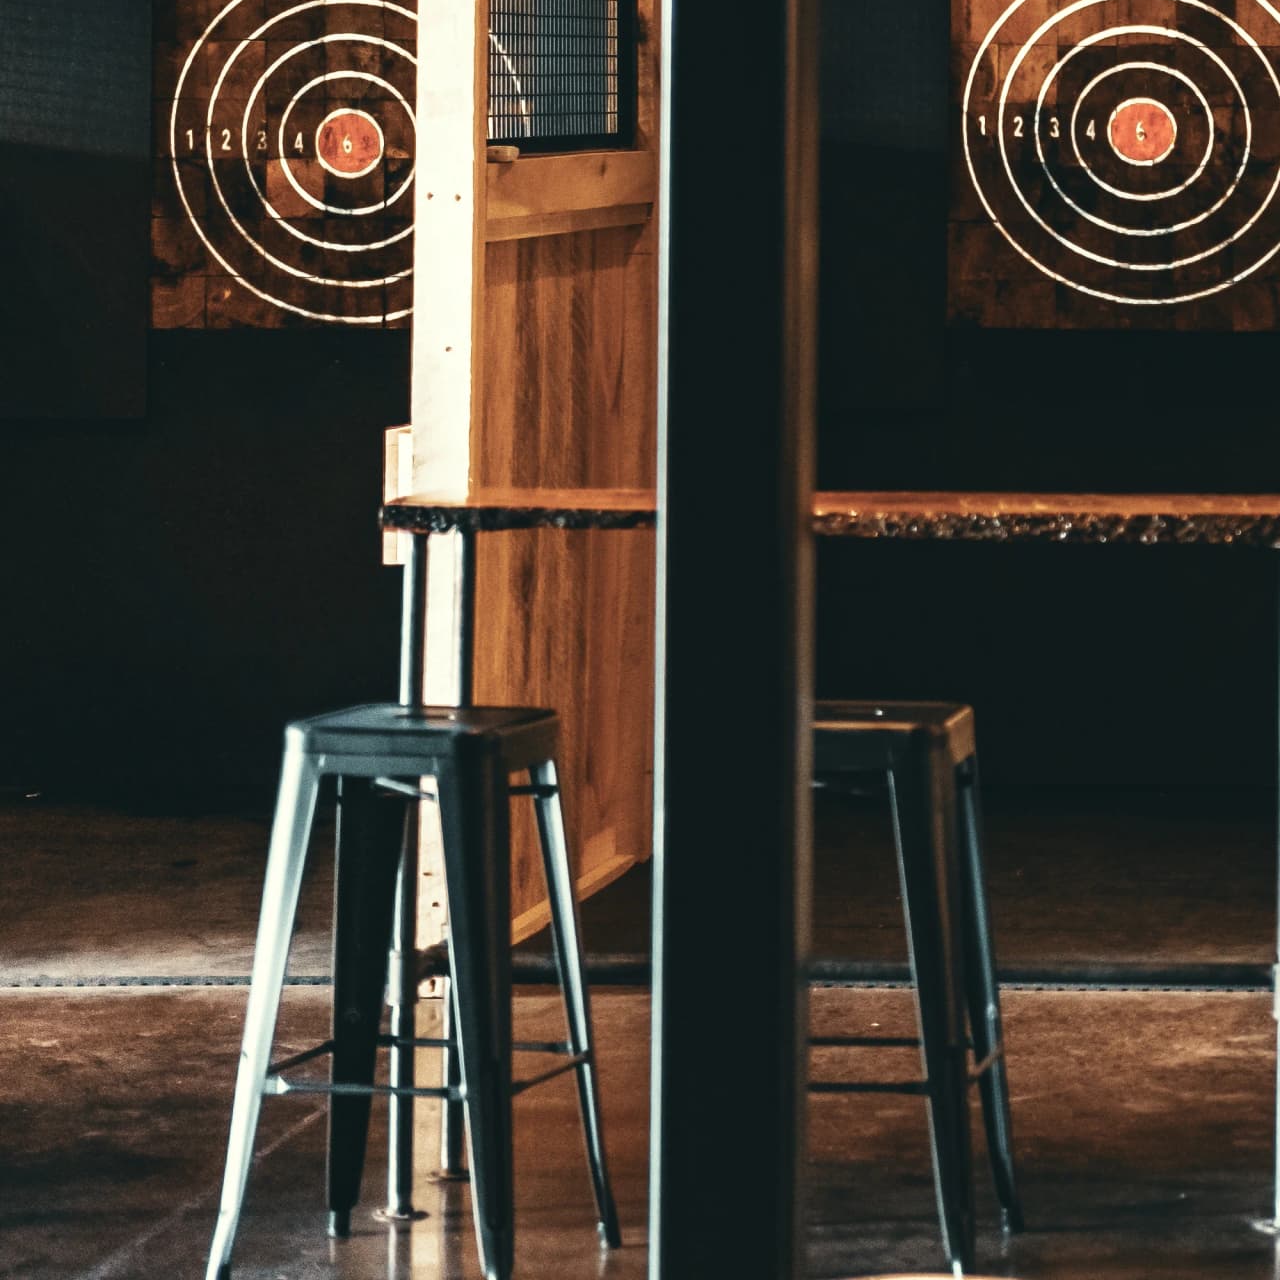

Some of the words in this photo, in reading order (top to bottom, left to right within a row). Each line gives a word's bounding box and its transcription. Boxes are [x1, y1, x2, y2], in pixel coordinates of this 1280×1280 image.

[978, 115, 986, 136] 1
[1013, 116, 1023, 137] 2
[1050, 117, 1060, 138] 3
[1086, 119, 1096, 141] 4
[1135, 121, 1146, 142] 6
[186, 129, 194, 150] 1
[221, 128, 232, 151] 2
[257, 130, 267, 151] 3
[294, 131, 304, 153] 4
[342, 134, 352, 154] 6
